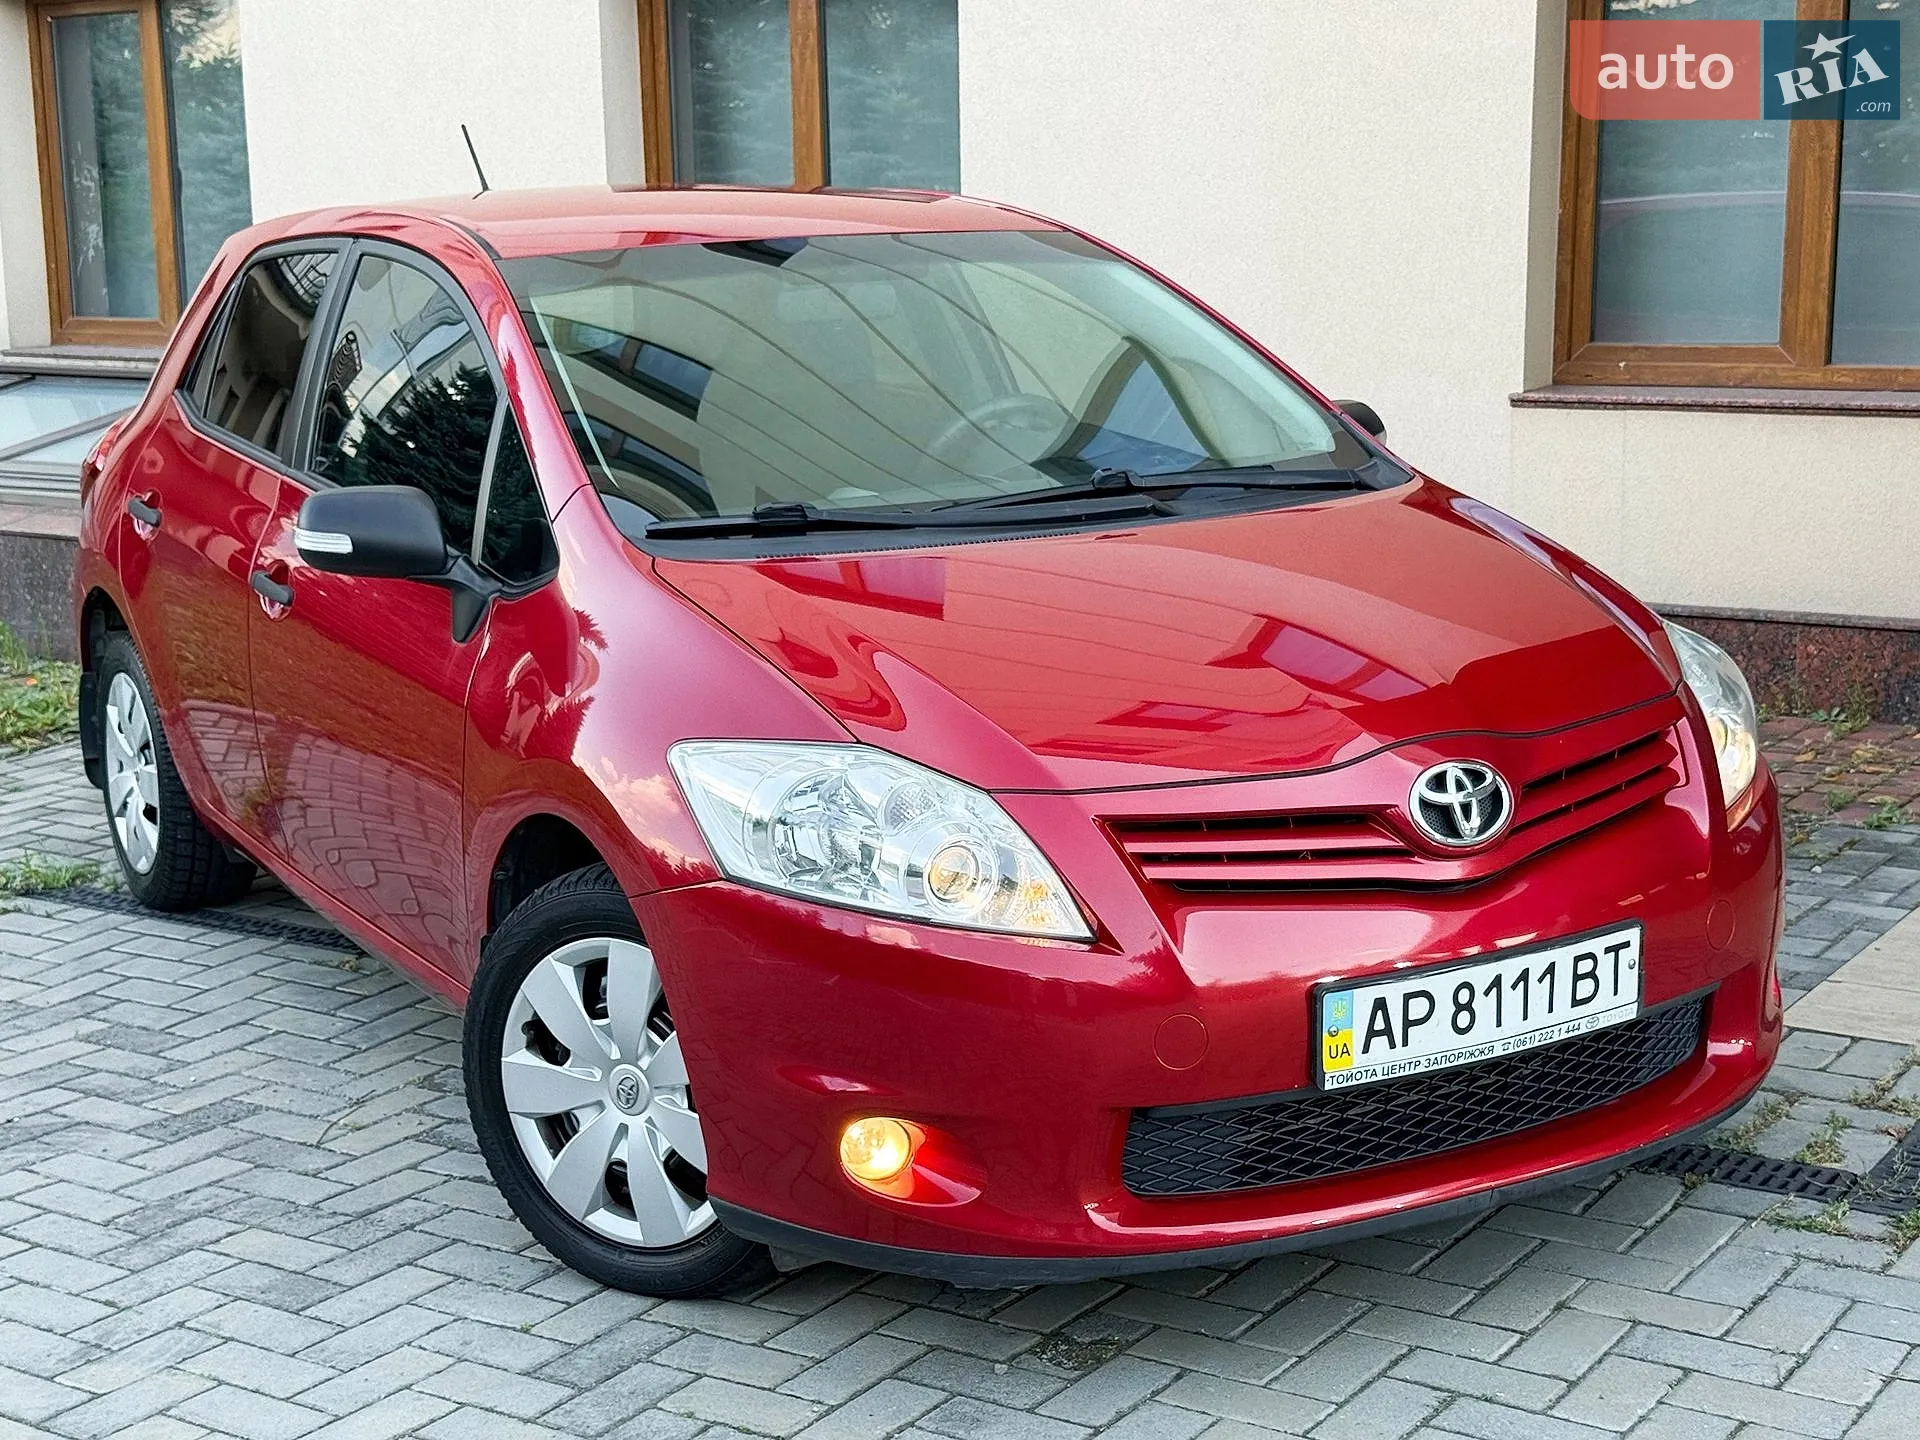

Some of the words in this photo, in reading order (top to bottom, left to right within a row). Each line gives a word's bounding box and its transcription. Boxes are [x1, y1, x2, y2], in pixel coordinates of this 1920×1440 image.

[1361, 990, 1436, 1055] AP
[1450, 960, 1557, 1036] 8111
[1571, 940, 1632, 1009] BT
[1328, 1042, 1351, 1059] UA
[1328, 1067, 1379, 1086] ТОЙОТА
[1381, 1060, 1422, 1078] ЦЕНТР
[1424, 1045, 1495, 1068] ЗАПОРІЖЖЯ
[1513, 1034, 1536, 1050] (061)
[1538, 1030, 1554, 1043] 222
